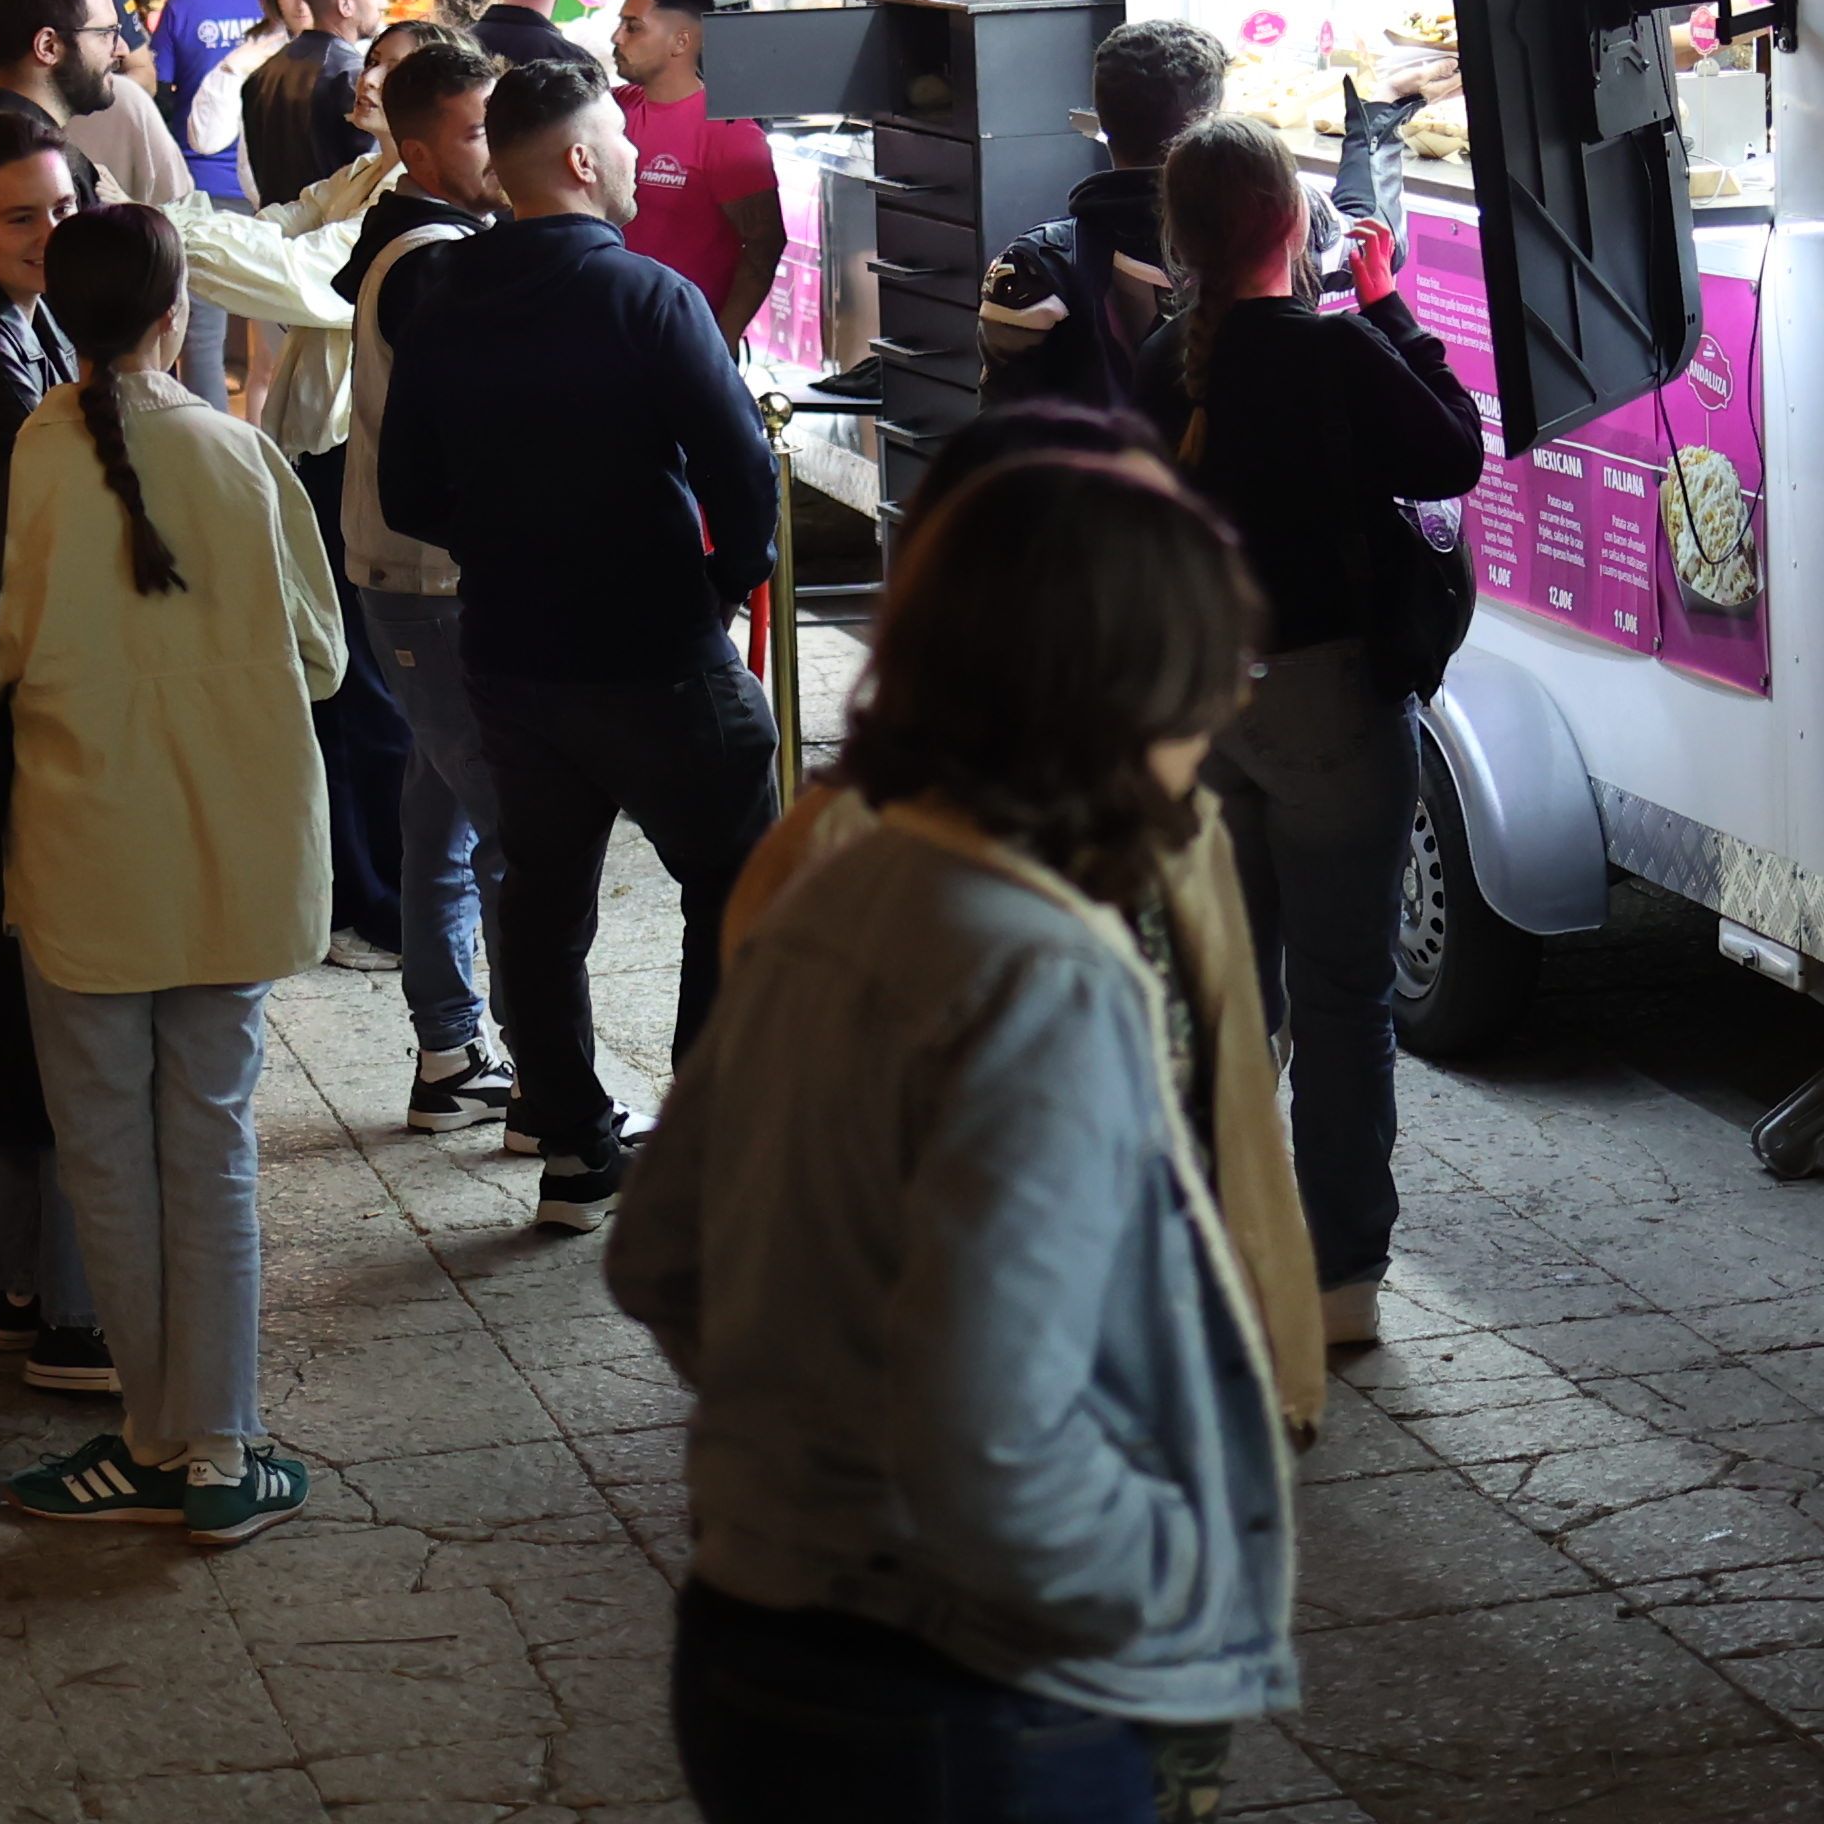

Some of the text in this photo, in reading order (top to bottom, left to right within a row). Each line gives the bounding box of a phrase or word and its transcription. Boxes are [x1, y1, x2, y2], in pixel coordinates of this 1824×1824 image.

[1689, 359, 1727, 397] ANDALUZA
[1532, 448, 1583, 478] MEXICANA
[1603, 466, 1645, 498] ITALIANA
[1488, 563, 1511, 589] 14,00€
[1548, 585, 1573, 611] 12,00€
[1613, 608, 1639, 635] 11,00€
